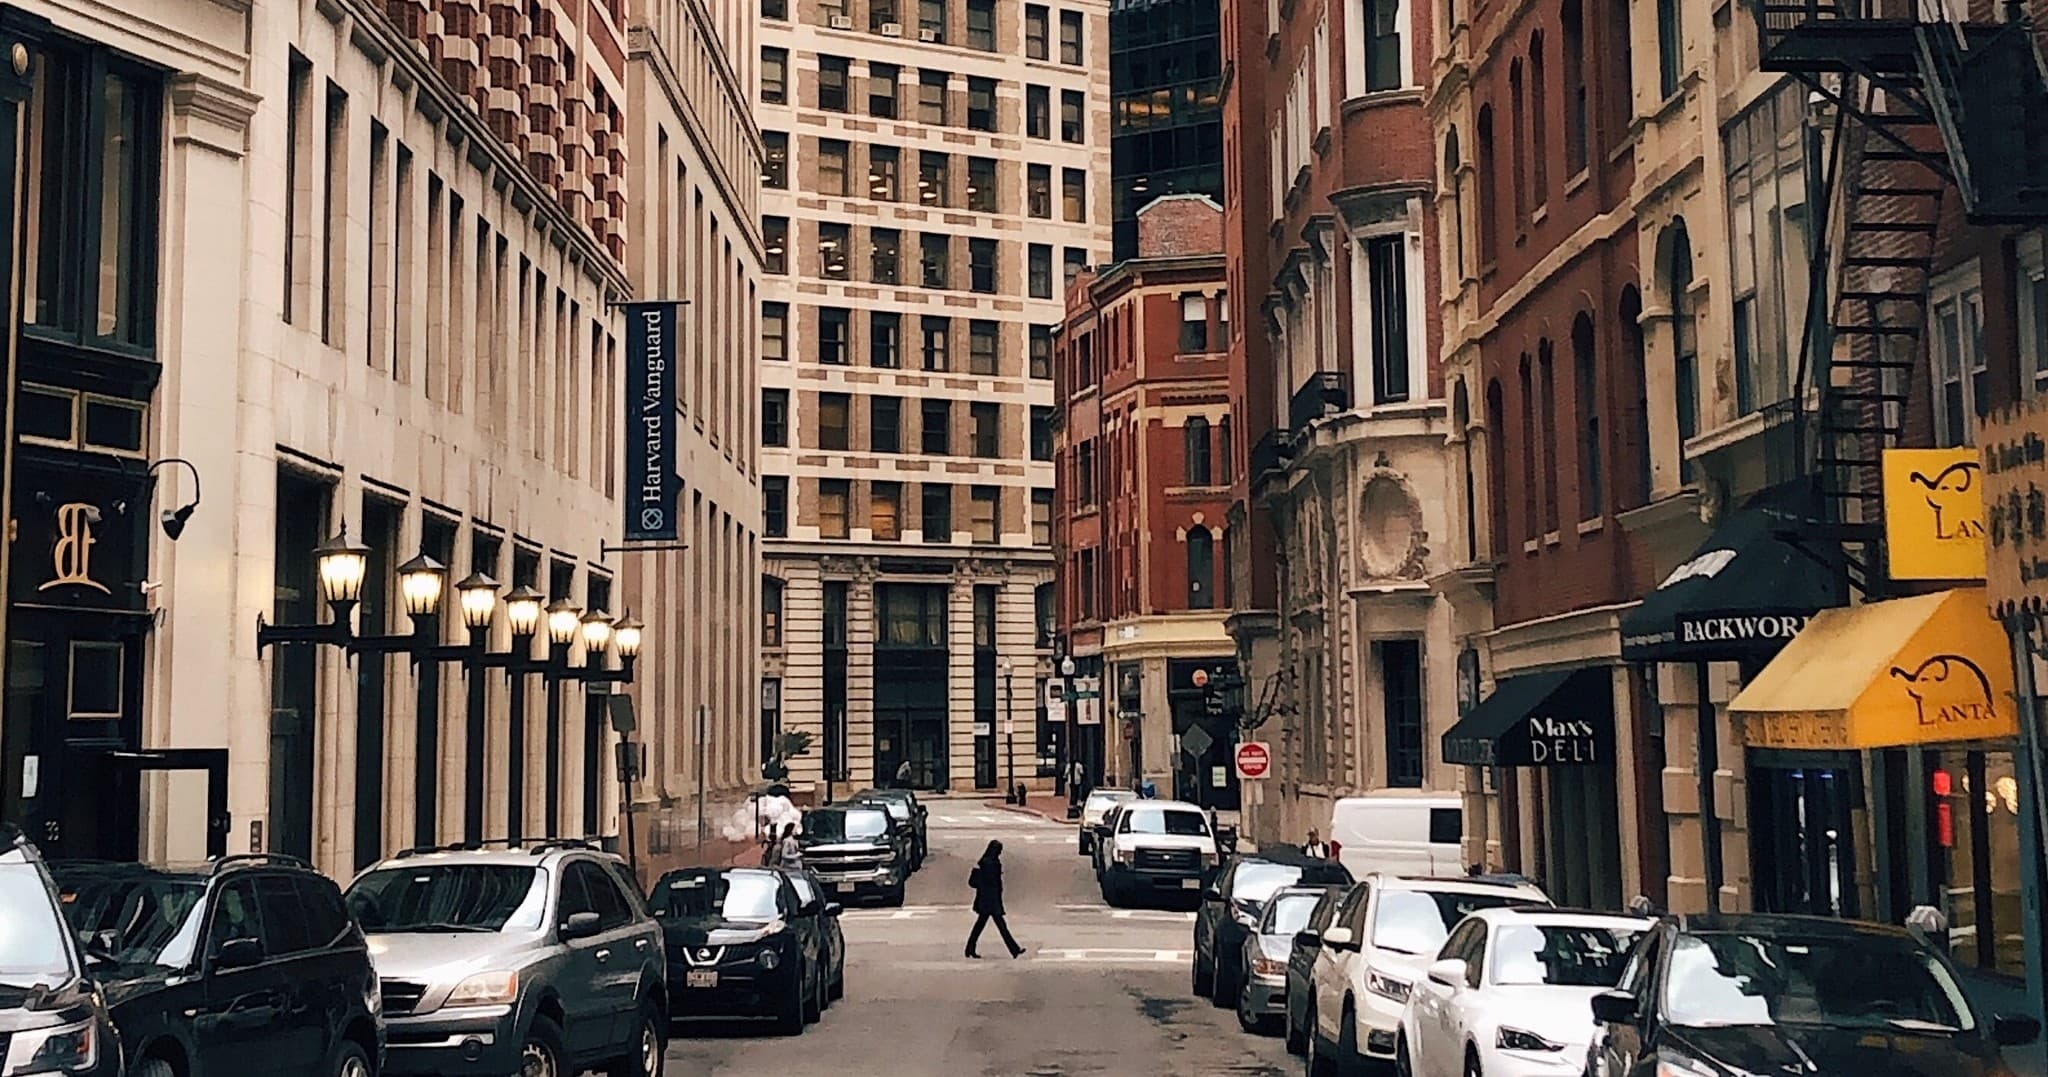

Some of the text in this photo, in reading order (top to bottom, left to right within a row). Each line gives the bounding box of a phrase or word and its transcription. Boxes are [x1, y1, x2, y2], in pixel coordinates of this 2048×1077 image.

[642, 310, 665, 502] Harvard Vanguard
[1683, 616, 1810, 642] BACKWOR
[1530, 717, 1593, 737] Max's
